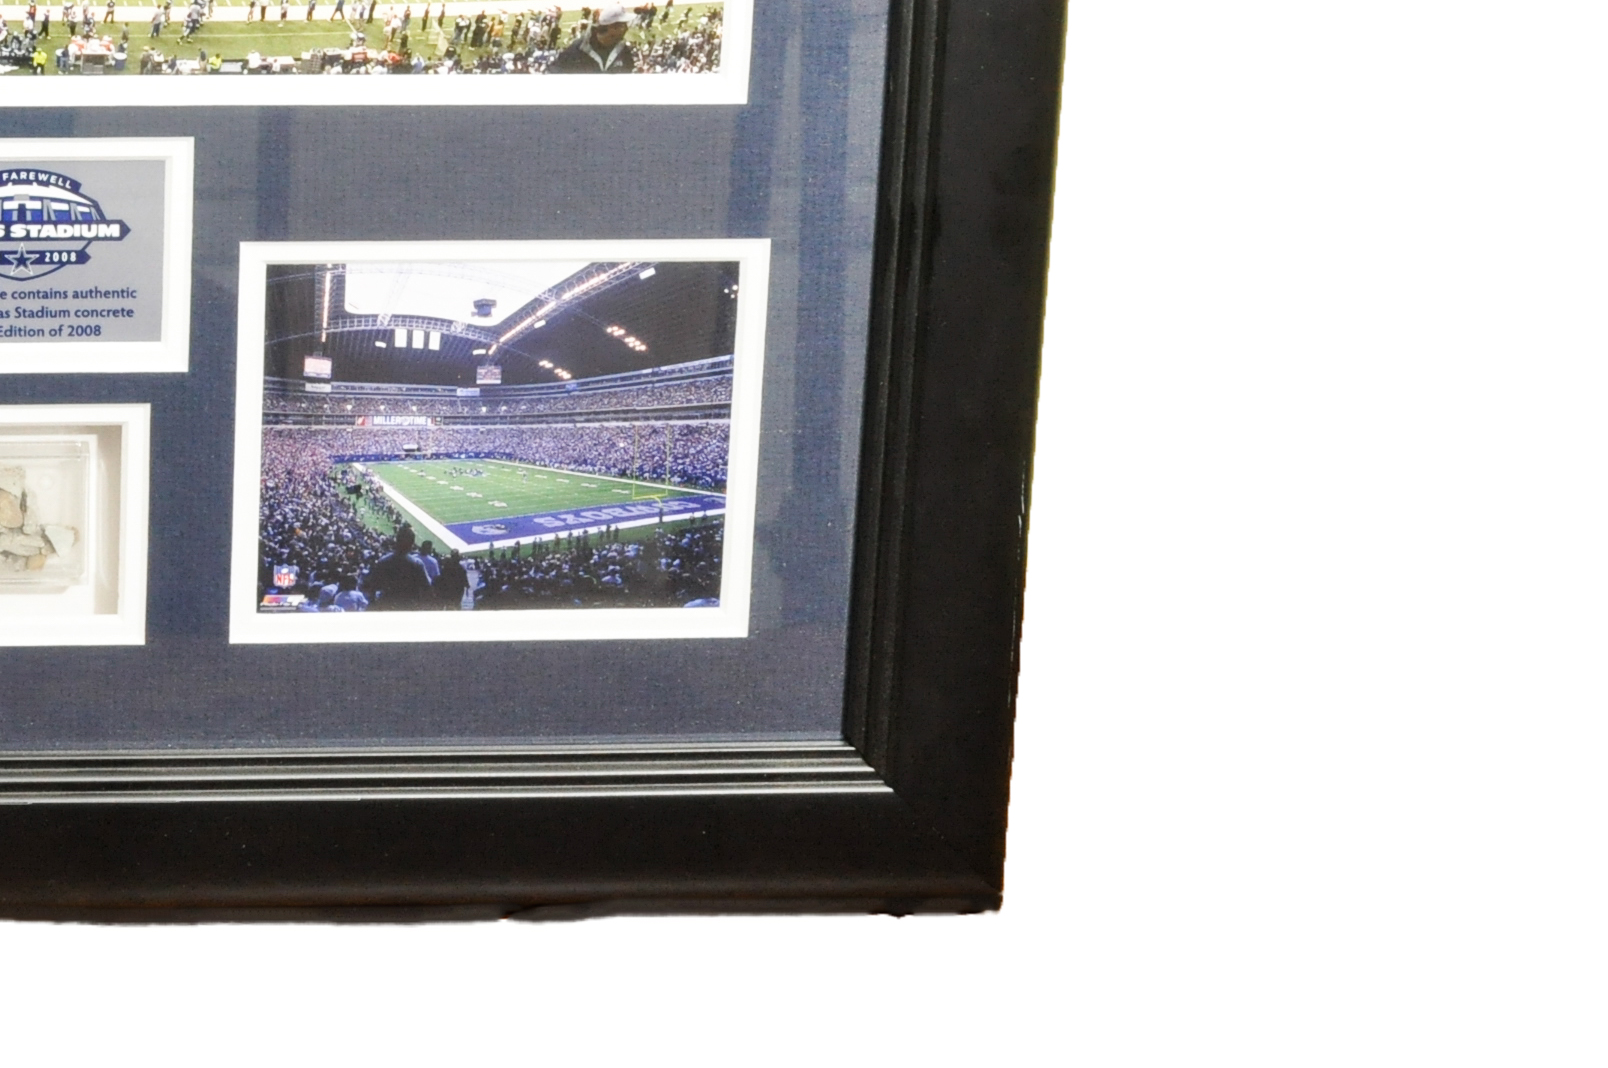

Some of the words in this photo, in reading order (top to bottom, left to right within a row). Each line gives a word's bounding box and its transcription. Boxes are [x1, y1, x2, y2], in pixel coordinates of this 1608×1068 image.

[2, 171, 72, 190] FAREWELL
[9, 223, 121, 238] STADIUM
[44, 251, 77, 262] 2008
[10, 287, 69, 300] contains
[71, 285, 138, 300] authentic
[14, 305, 71, 319] Stadium
[73, 307, 135, 319] concrete
[48, 323, 65, 338] of
[67, 324, 102, 337] 2008
